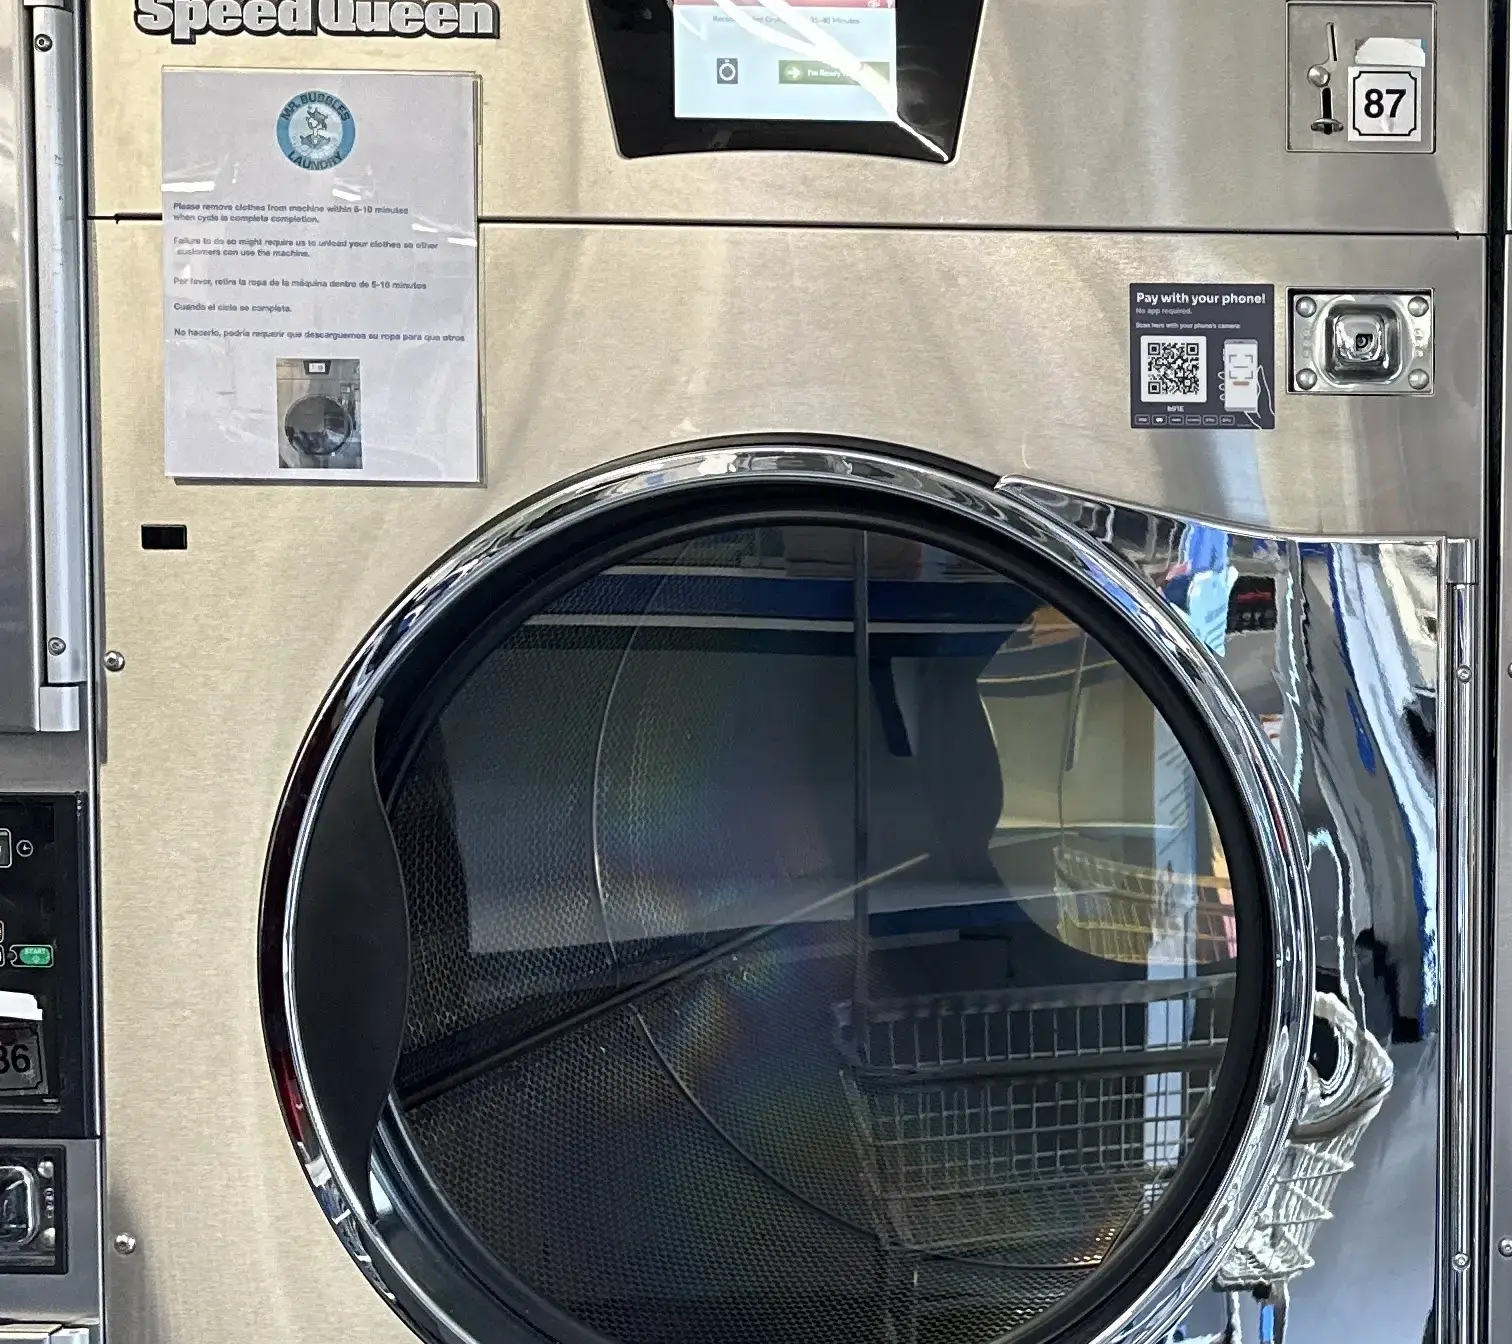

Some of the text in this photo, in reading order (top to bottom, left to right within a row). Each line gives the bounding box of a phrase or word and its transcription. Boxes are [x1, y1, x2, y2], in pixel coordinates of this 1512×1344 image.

[281, 92, 350, 121] MR. BUBBLES
[1364, 88, 1406, 118] 87
[287, 151, 343, 170] LAUNDRY
[375, 206, 408, 214] minutes
[198, 214, 218, 222] cycle
[230, 215, 268, 223] complete
[271, 216, 319, 224] completion.
[239, 238, 262, 247] might
[265, 239, 293, 248] require
[177, 248, 221, 256] customers
[273, 249, 310, 257] machine.
[249, 279, 267, 288] ropa
[282, 279, 289, 287] la
[1136, 292, 1266, 305] Pay with your phone!
[174, 303, 206, 311] Cuando
[252, 330, 284, 339] requerir
[287, 331, 302, 339] que
[304, 331, 366, 340] descarguemos
[403, 334, 422, 342] para
[443, 334, 465, 342] otros
